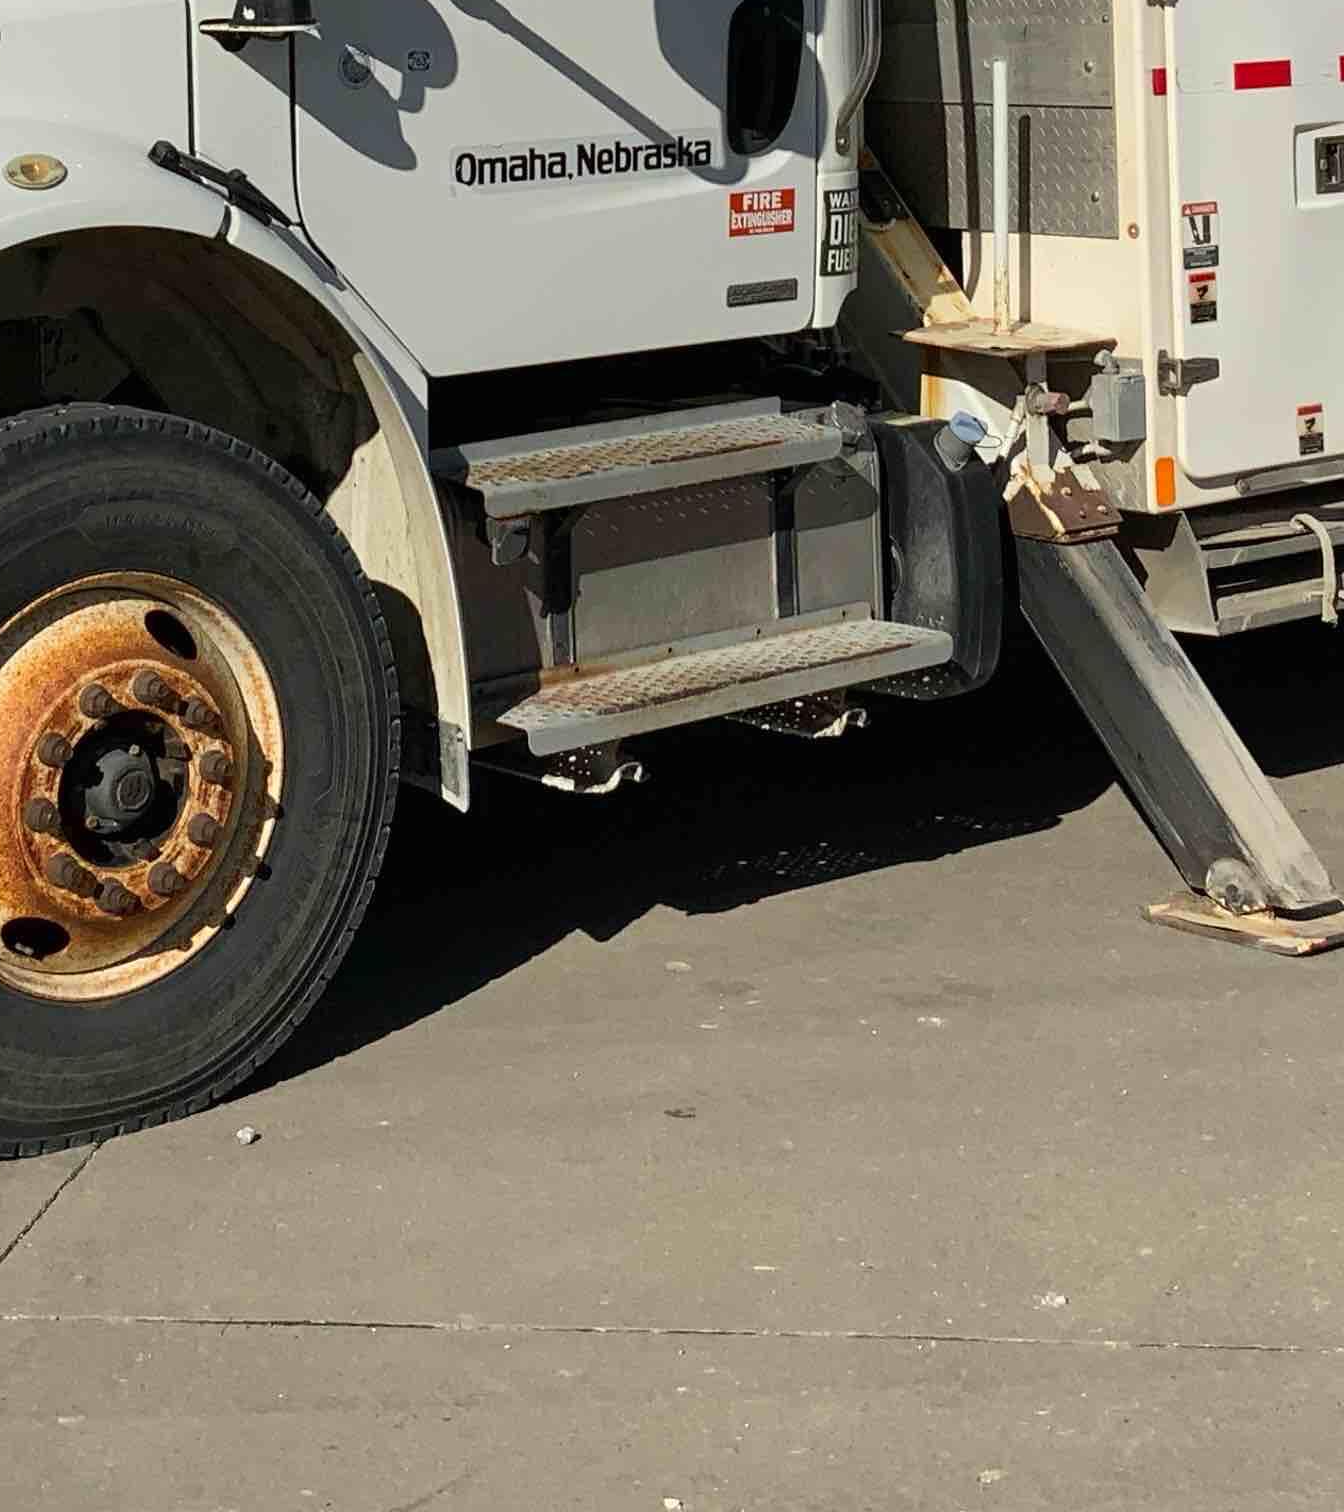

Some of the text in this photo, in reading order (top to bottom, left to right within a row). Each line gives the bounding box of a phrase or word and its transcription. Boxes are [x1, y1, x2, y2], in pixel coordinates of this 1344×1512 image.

[456, 136, 712, 186] Omaha, Nebraska
[742, 191, 783, 210] FIRE
[731, 208, 793, 229] EXTINGUISHER
